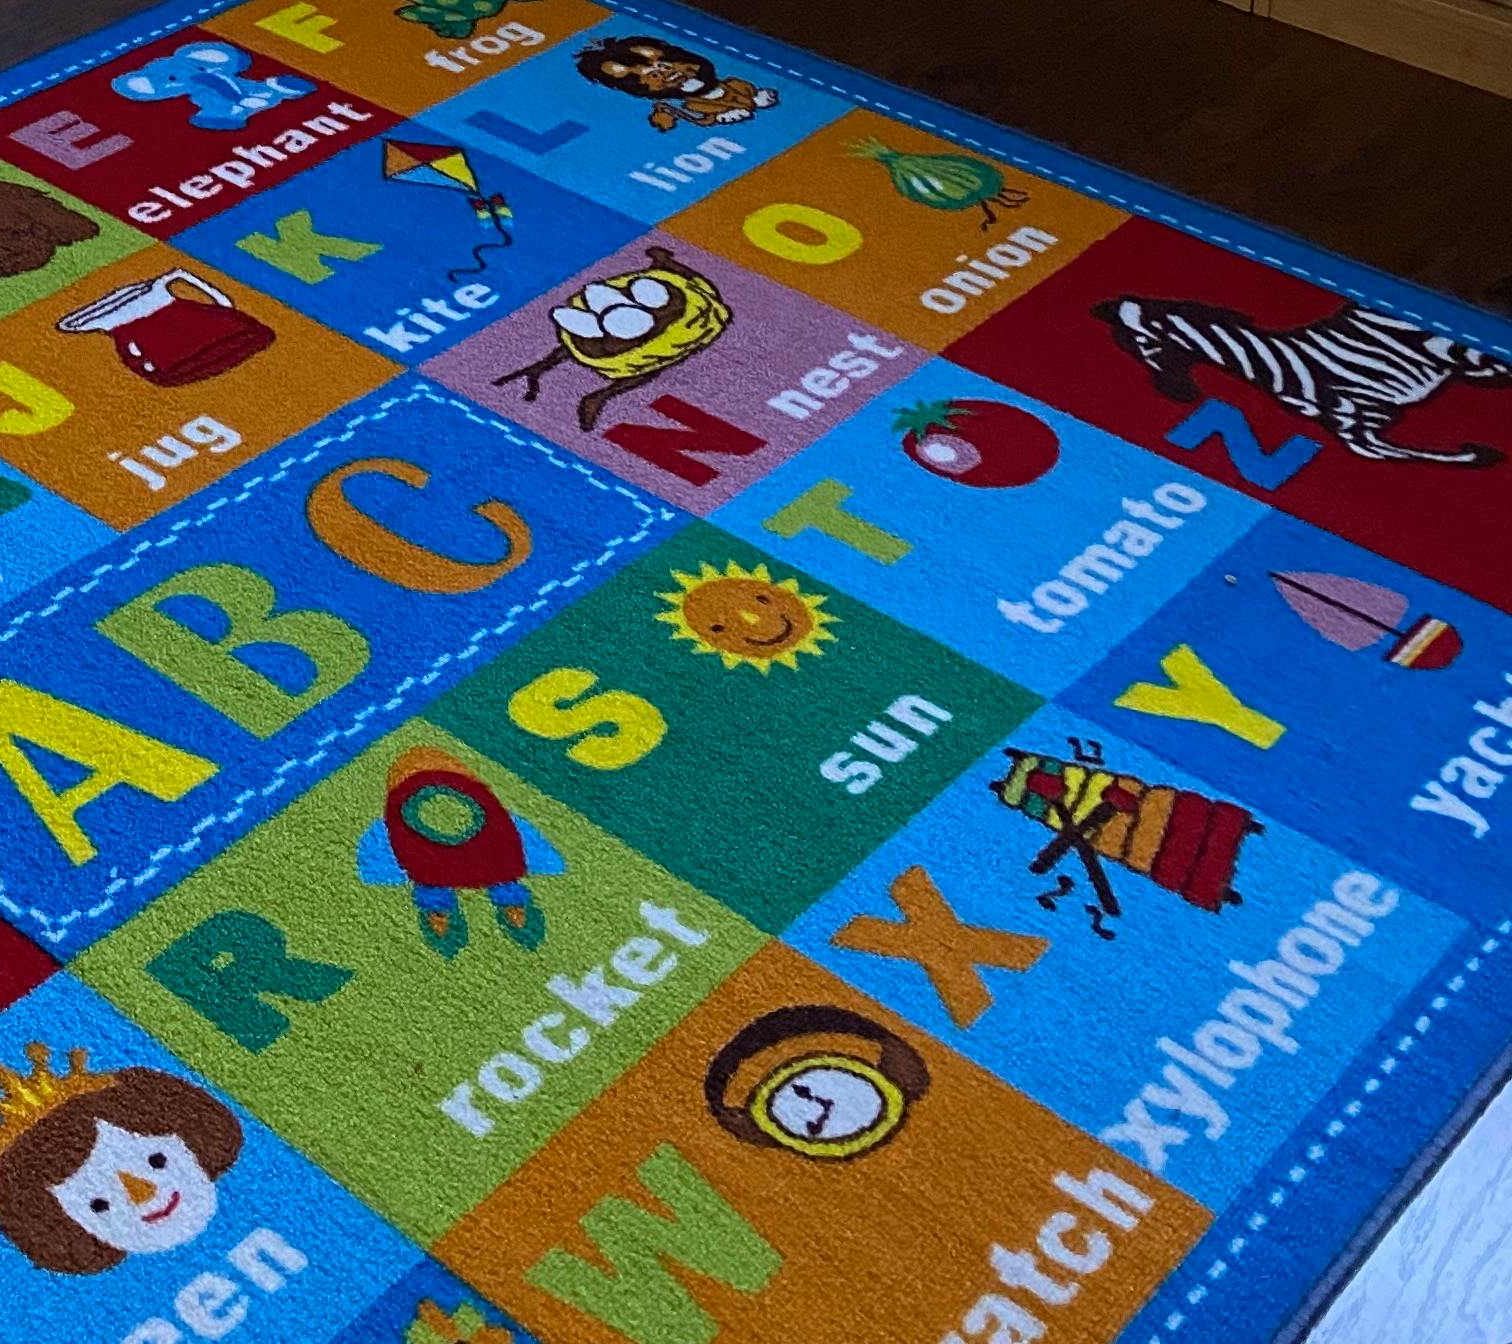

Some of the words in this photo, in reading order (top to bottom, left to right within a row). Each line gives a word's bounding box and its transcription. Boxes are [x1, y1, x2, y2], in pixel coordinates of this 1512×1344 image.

[256, 2, 346, 55] F
[423, 18, 546, 76] frog
[128, 100, 375, 224] elephant
[628, 130, 747, 196] lion
[234, 208, 384, 285] K
[918, 220, 1058, 318] onion
[362, 277, 502, 356] kite
[766, 326, 906, 422] nest
[106, 413, 244, 493] jug
[993, 477, 1208, 635] tomato
[820, 688, 955, 799] sun
[829, 864, 1052, 1030] X
[438, 898, 713, 1143] rocket
[1101, 867, 1402, 1176] xylophone
